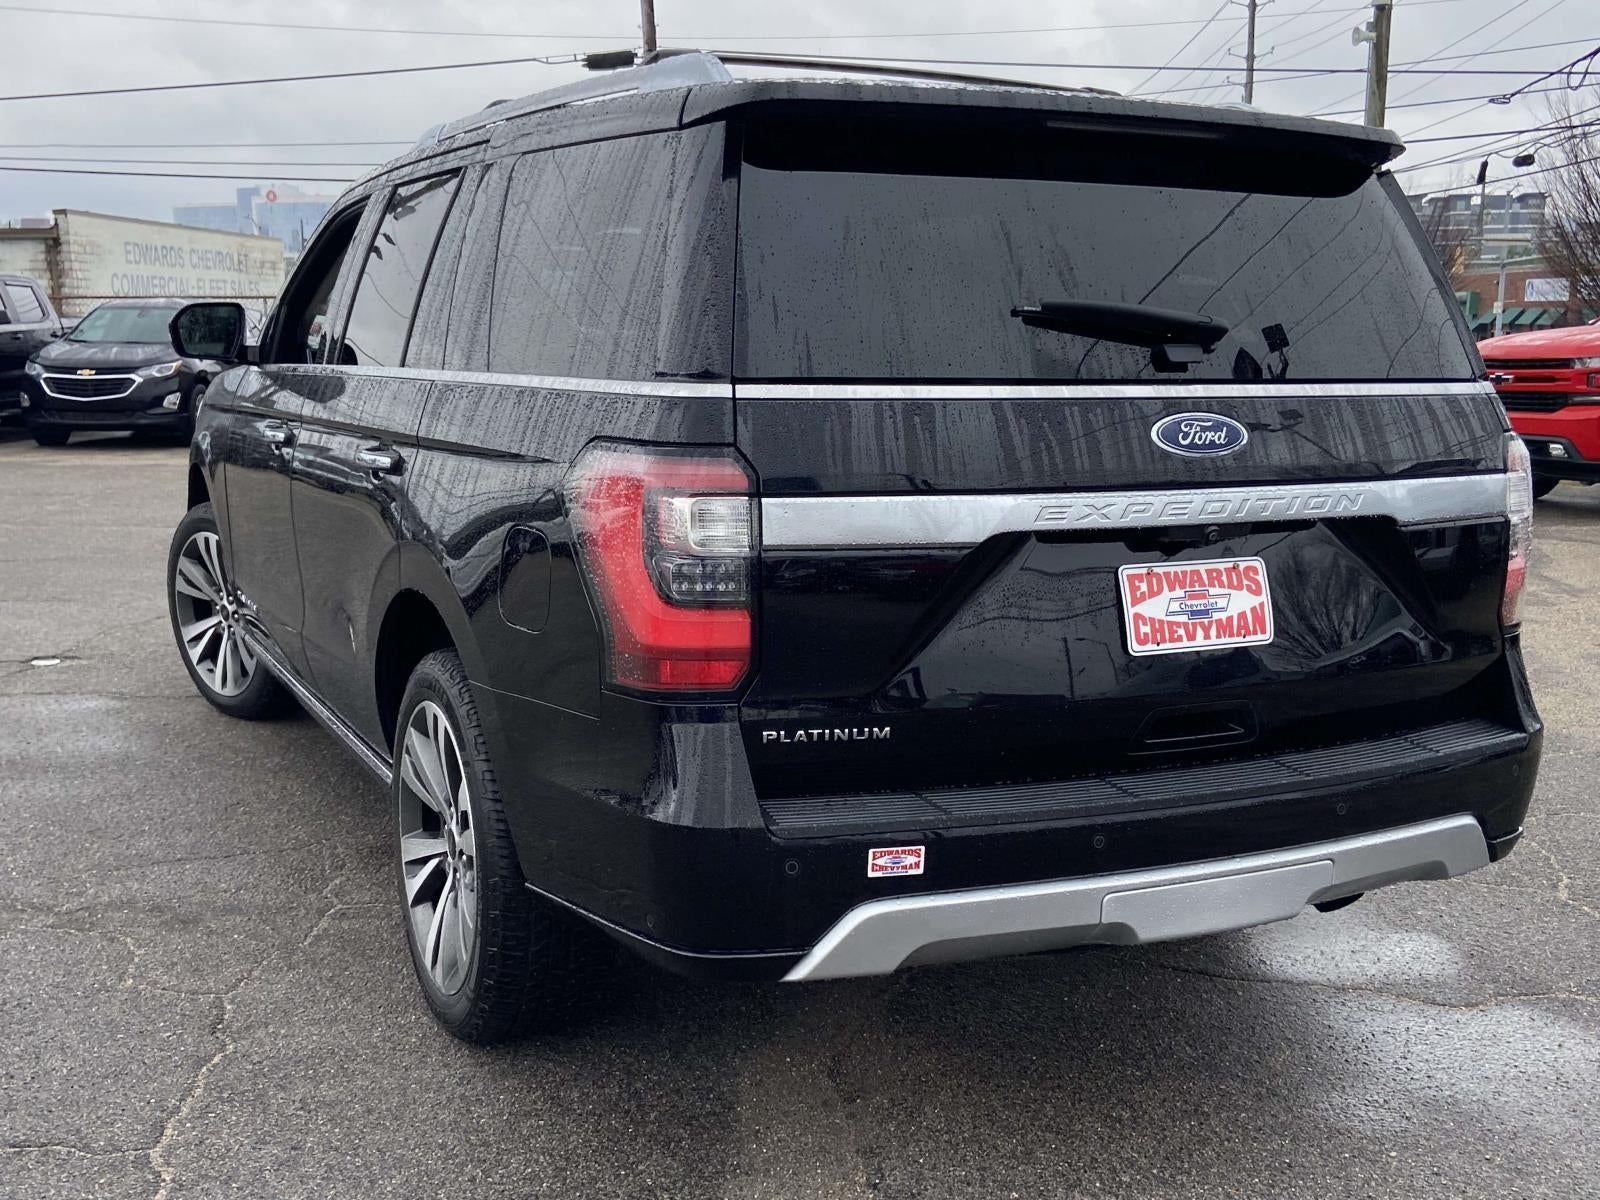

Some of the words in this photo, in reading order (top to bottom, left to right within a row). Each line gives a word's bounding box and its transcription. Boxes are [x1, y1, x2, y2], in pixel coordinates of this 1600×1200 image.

[124, 242, 184, 269] EDWARDS
[189, 249, 249, 273] CHEVROLET
[230, 281, 260, 297] SALES
[1178, 420, 1228, 445] Ford
[1033, 493, 1364, 524] EXPEDITION
[1126, 565, 1263, 608] EDWARDS
[1178, 600, 1218, 610] Chevrolet
[1132, 601, 1267, 646] CHEVYMAN
[762, 727, 891, 743] PLATINUM
[872, 848, 922, 861] EDWARDS
[871, 860, 921, 872] CHEVYMAN
